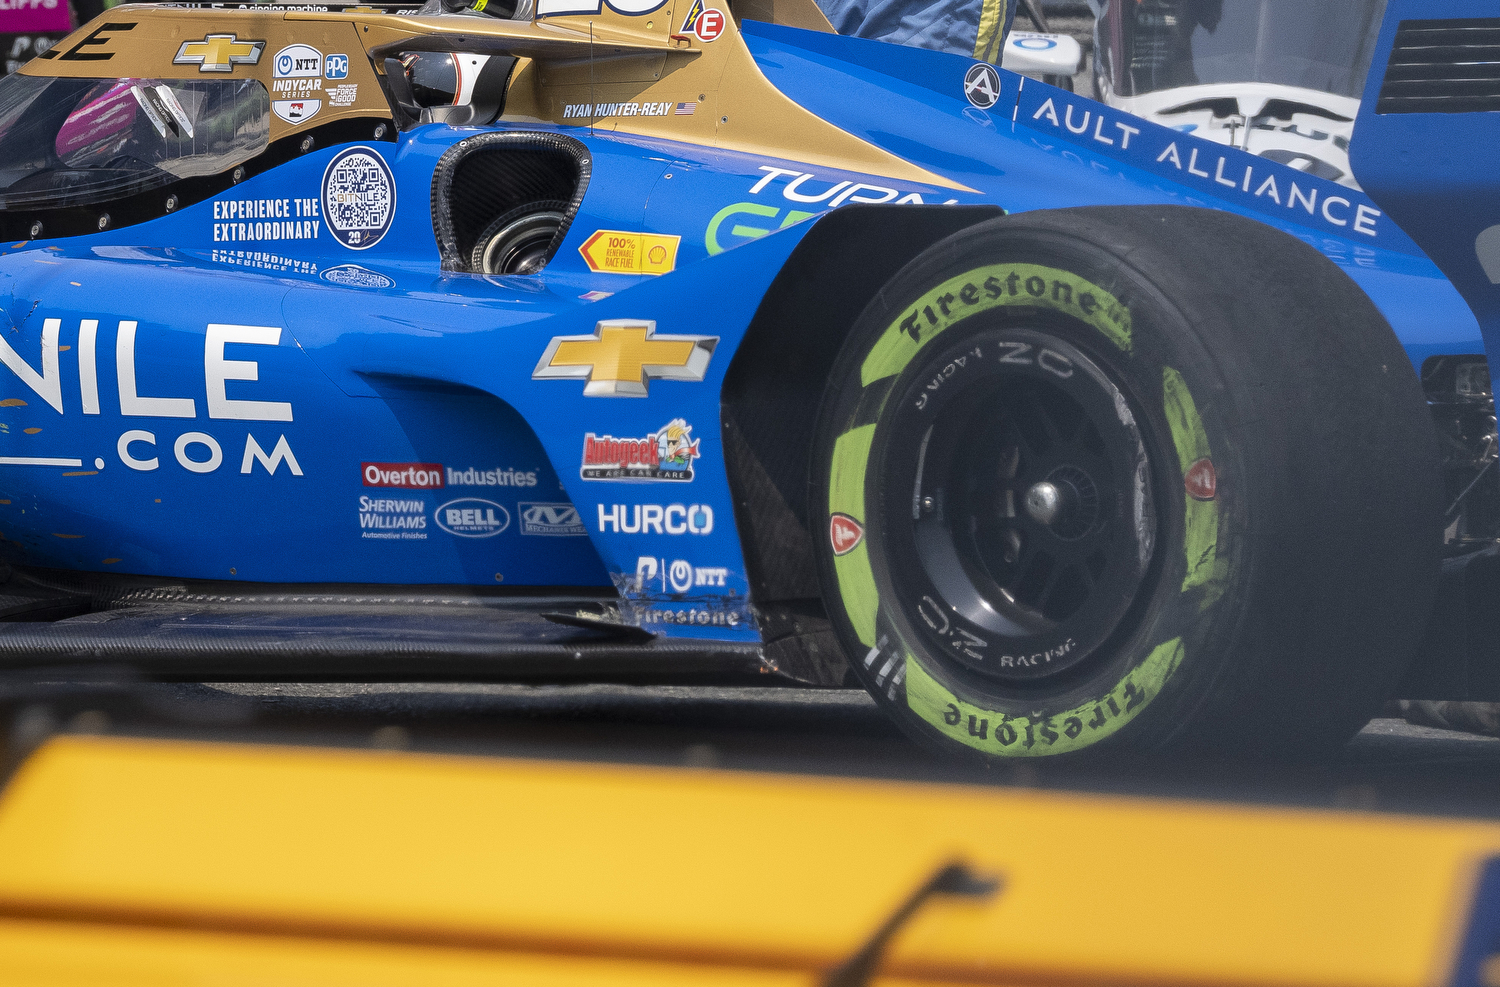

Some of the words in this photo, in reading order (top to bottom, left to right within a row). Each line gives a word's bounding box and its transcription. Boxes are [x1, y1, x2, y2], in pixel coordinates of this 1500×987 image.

[295, 58, 318, 70] NTT
[326, 57, 347, 77] PPG
[272, 79, 322, 92] INDYCAR
[281, 91, 311, 99] SERIES
[562, 103, 592, 118] RYAN
[594, 101, 673, 117] HUNTER-REAY
[1034, 98, 1140, 150] AULT
[1157, 141, 1382, 236] ALLIANCE
[337, 193, 381, 203] BITNILE
[213, 199, 290, 220] EXPERIENCE
[294, 198, 319, 217] THE
[213, 220, 320, 242] EXTRAORDINARY
[348, 231, 361, 244] 20
[608, 237, 636, 249] 100%
[606, 249, 635, 258] RENEWABLE
[605, 258, 620, 268] RACE
[621, 259, 635, 269] FUEL
[900, 270, 1105, 344] Firestone
[94, 429, 304, 476] .COM
[584, 436, 659, 468] Autogeek
[364, 465, 442, 487] Overton
[446, 467, 538, 487] Industries
[358, 495, 425, 513] SHERWIN
[358, 513, 427, 529] WILLIAMS
[446, 508, 500, 526] BELL
[598, 504, 713, 534] HURCO
[361, 531, 400, 539] Automotive
[401, 532, 428, 540] Finishes
[570, 525, 588, 533] WEA
[695, 568, 728, 586] NTT
[943, 682, 1146, 751] Firestone
